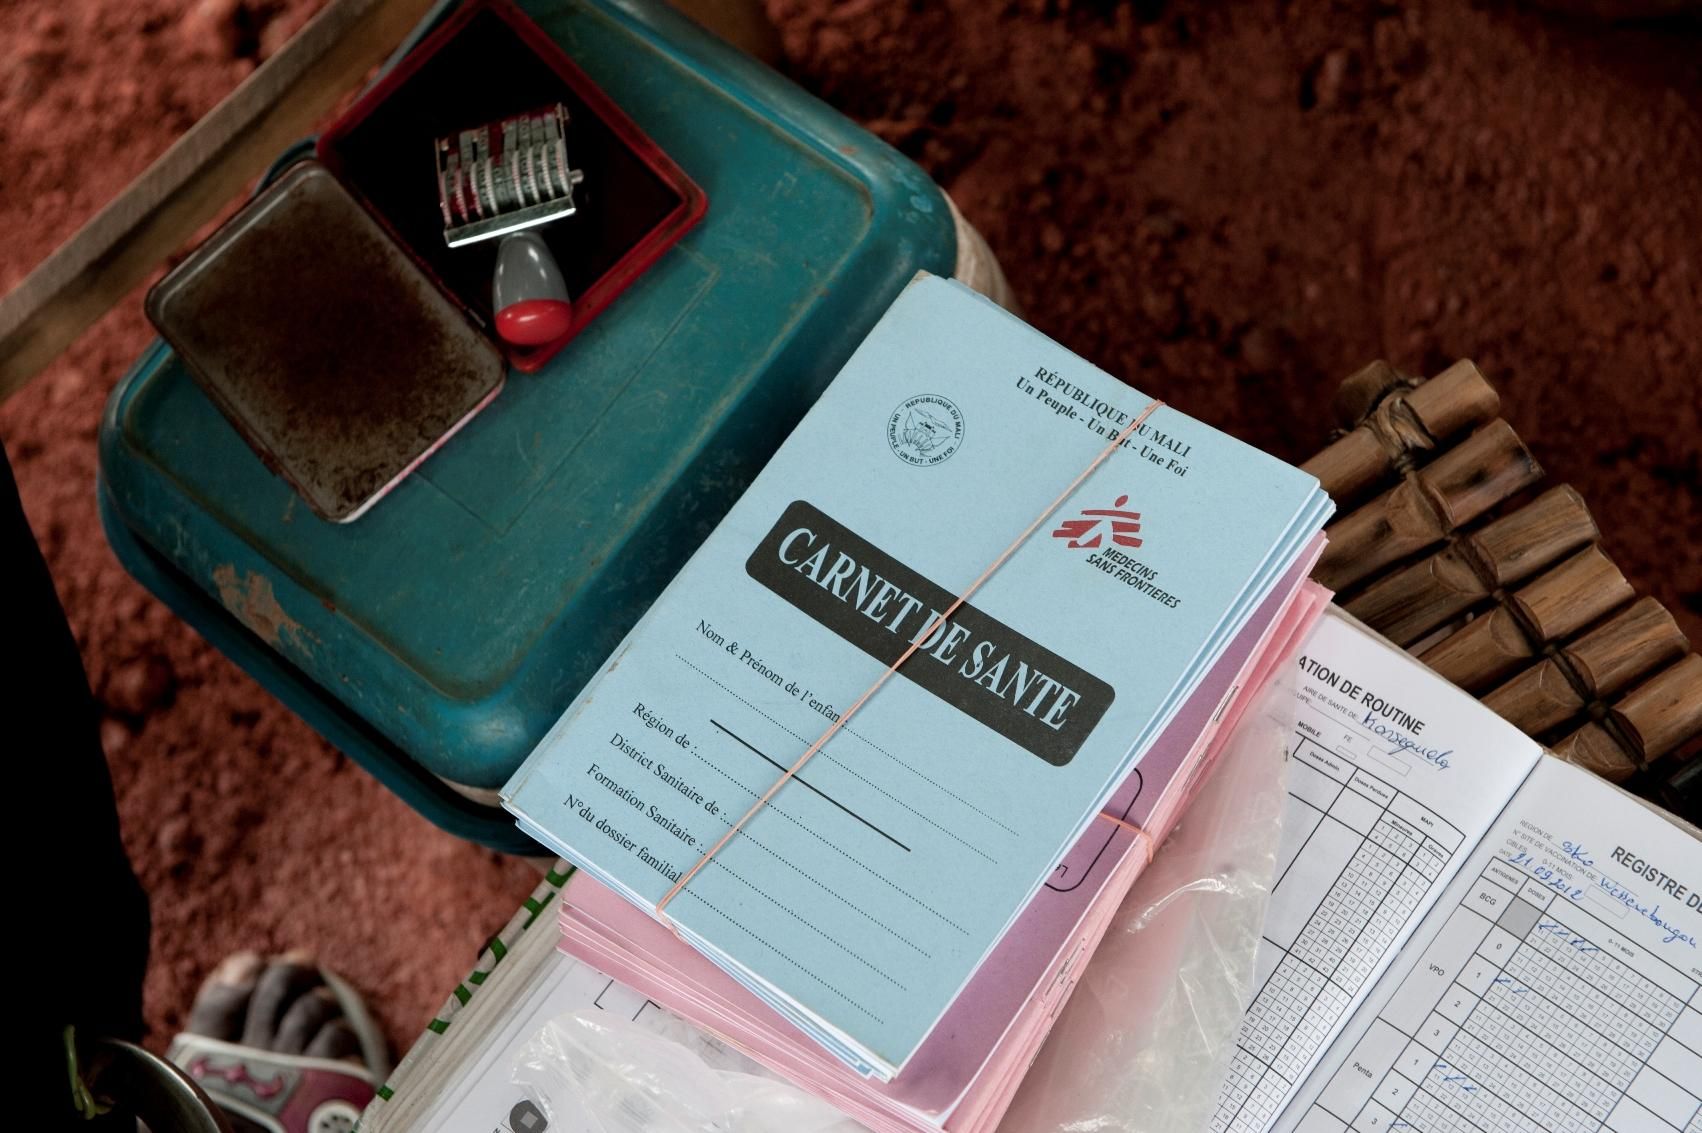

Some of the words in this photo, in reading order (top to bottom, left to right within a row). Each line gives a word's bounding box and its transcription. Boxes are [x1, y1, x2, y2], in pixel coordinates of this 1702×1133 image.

[950, 410, 960, 420] DU
[1016, 376, 1035, 395] Un
[1036, 388, 1078, 420] Peuple
[1087, 417, 1106, 436] Un
[1139, 445, 1165, 466] Une
[1166, 458, 1189, 477] Foi
[1034, 366, 1128, 426] RÉPUBLIQUE
[1149, 430, 1192, 458] MALI
[909, 456, 923, 464] BUT
[1086, 553, 1118, 574] SANS
[1113, 568, 1181, 609] FRONTIERES
[1102, 547, 1159, 581] MEDECINS
[778, 527, 924, 635] CARNET
[907, 608, 972, 666] DE
[957, 640, 1082, 731] SANTE
[696, 619, 725, 647] Nom
[725, 641, 739, 655] &
[739, 649, 784, 687] Prénom
[784, 681, 800, 697] de
[632, 702, 674, 739] Région
[675, 734, 690, 749] de
[1303, 686, 1318, 697] AIRE
[1328, 699, 1348, 714] SANTE
[1339, 679, 1362, 700] DE
[1360, 692, 1425, 736] ROUTINE
[1297, 721, 1322, 738] MOBILE
[609, 733, 654, 770] District
[653, 764, 704, 805] Sanitaire
[704, 800, 720, 816] de
[586, 763, 646, 812] Formation
[645, 805, 697, 847] Sanitaire
[595, 818, 638, 852] dossier
[636, 846, 684, 884] familial
[1544, 846, 1587, 877] VACCINATION
[1610, 846, 1688, 902] REGISTRE
[1479, 891, 1497, 906] BCG
[1428, 962, 1445, 977] VPO
[1352, 1061, 1373, 1079] Penta
